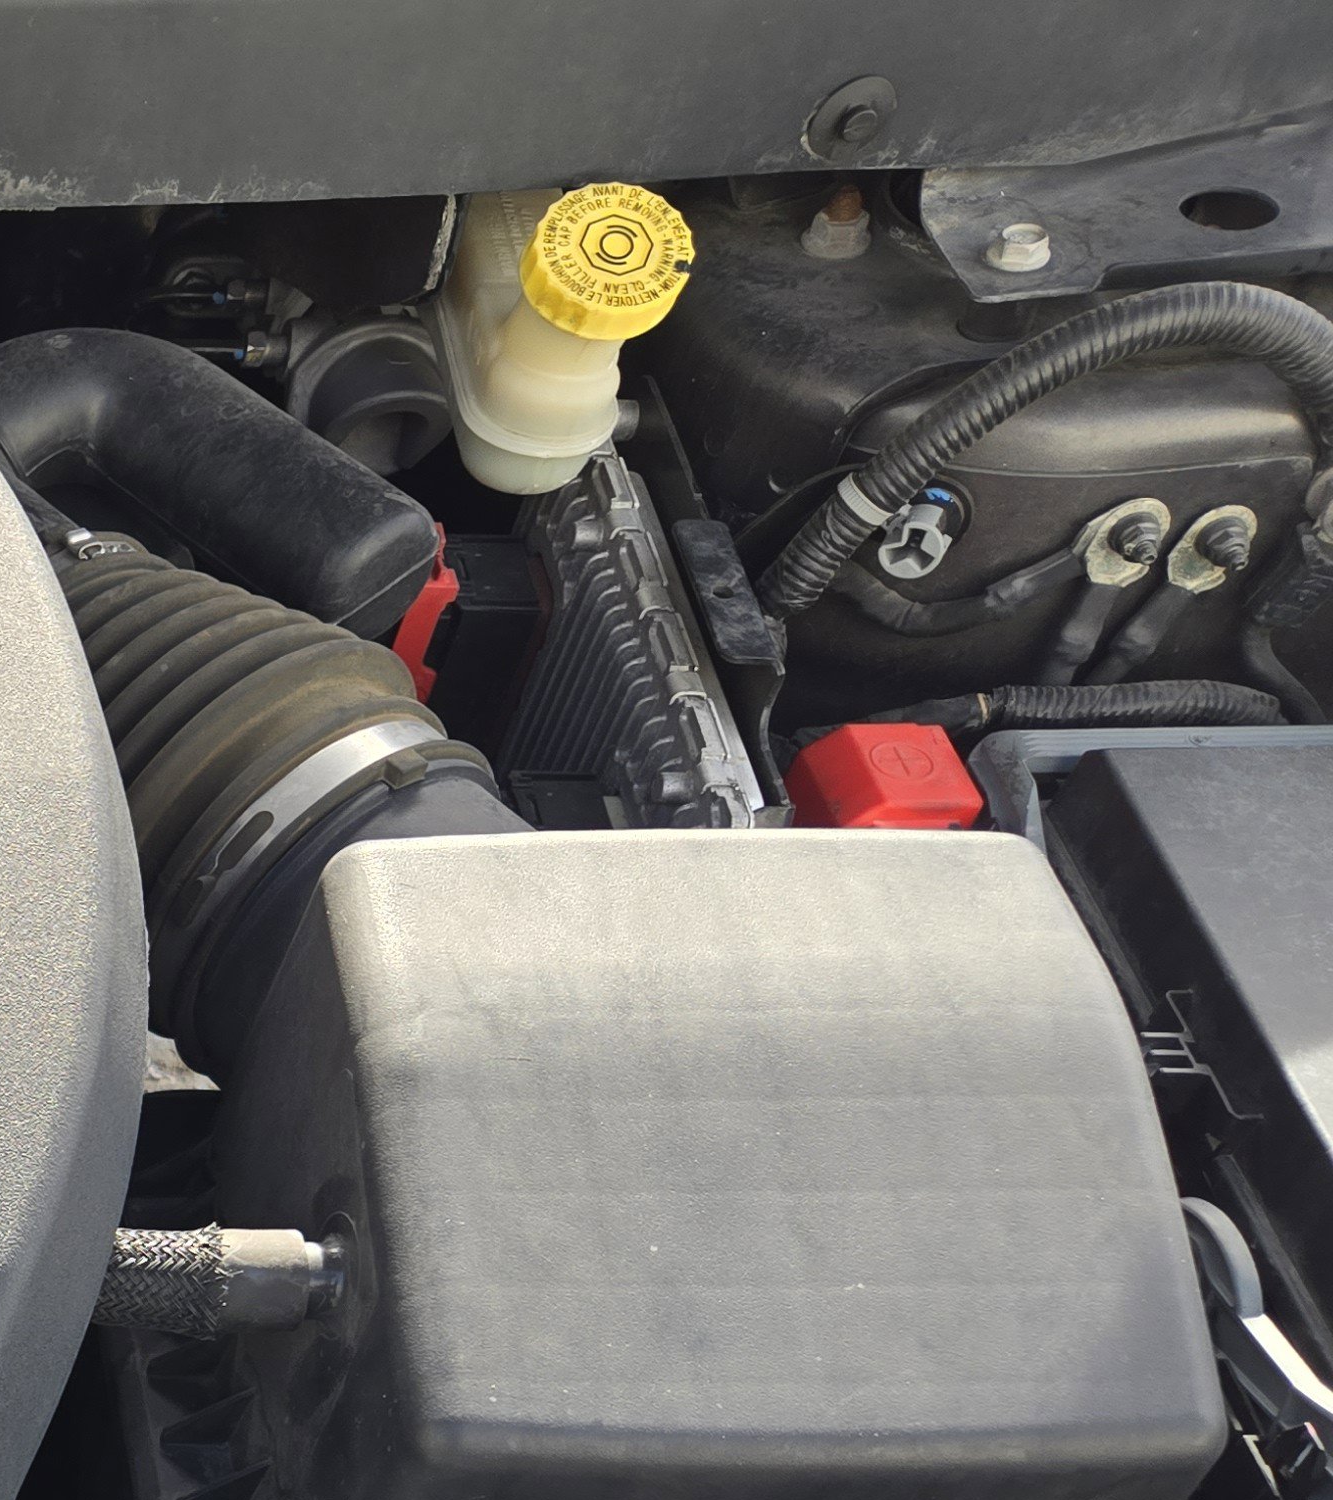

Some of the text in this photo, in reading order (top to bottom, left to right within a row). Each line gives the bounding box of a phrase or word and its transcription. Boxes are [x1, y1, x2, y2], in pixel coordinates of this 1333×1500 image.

[592, 185, 624, 197] AVANT
[628, 187, 644, 200] DE
[543, 190, 589, 244] REMPLISSAGE
[566, 197, 612, 224] BEFORE
[558, 226, 572, 247] CAP
[543, 245, 557, 258] DE
[548, 259, 587, 296] BOUCHON
[561, 253, 597, 289] FILLER
[603, 280, 645, 295] CLEAN
[585, 291, 603, 304] LE
